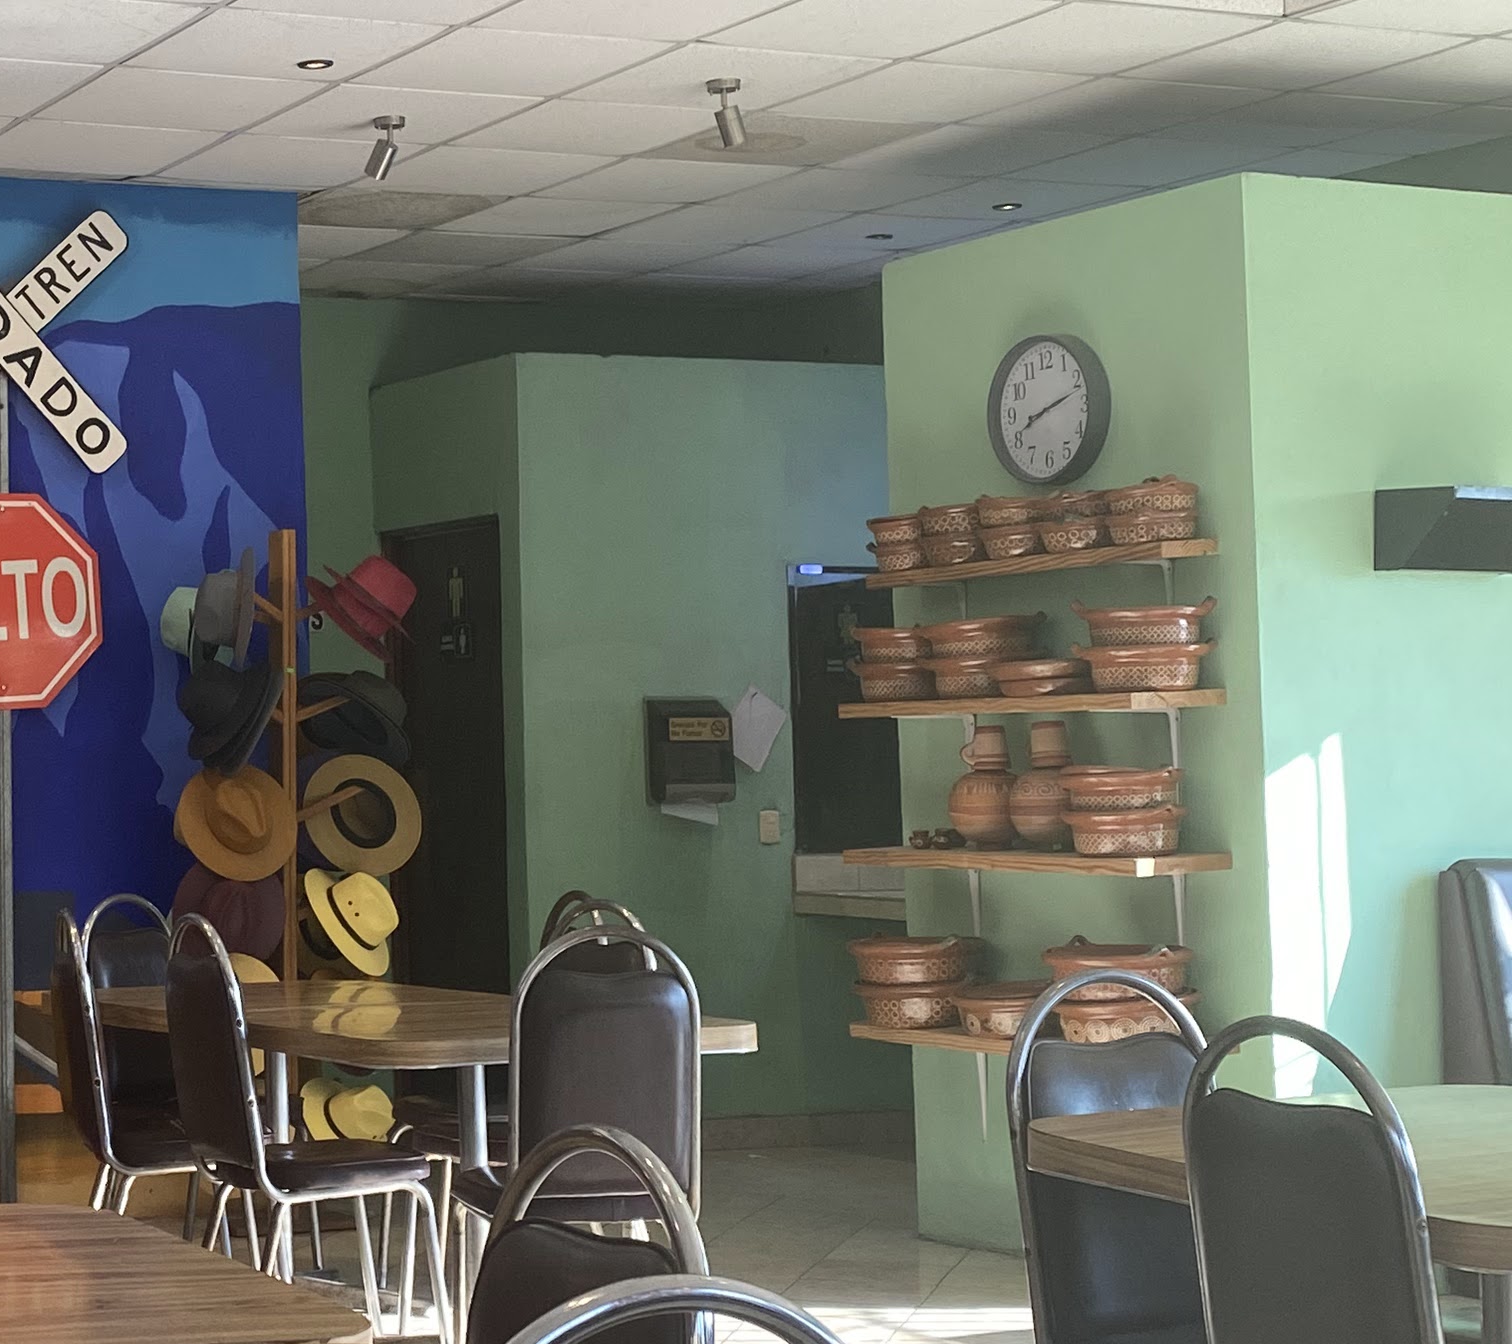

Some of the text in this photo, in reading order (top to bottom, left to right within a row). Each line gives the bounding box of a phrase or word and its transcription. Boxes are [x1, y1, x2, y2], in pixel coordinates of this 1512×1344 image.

[14, 221, 114, 320] TREN
[1038, 349, 1054, 371] 12
[1060, 353, 1068, 372] 1
[1023, 361, 1036, 381] 11
[1072, 369, 1082, 389] 2
[1013, 381, 1027, 401] 10
[1080, 394, 1088, 413] 3
[1007, 406, 1017, 425] 9
[1074, 419, 1083, 439] 4
[1014, 431, 1024, 449] 8
[1062, 440, 1072, 460] 5
[1028, 445, 1037, 465] 7
[1045, 450, 1055, 469] 6
